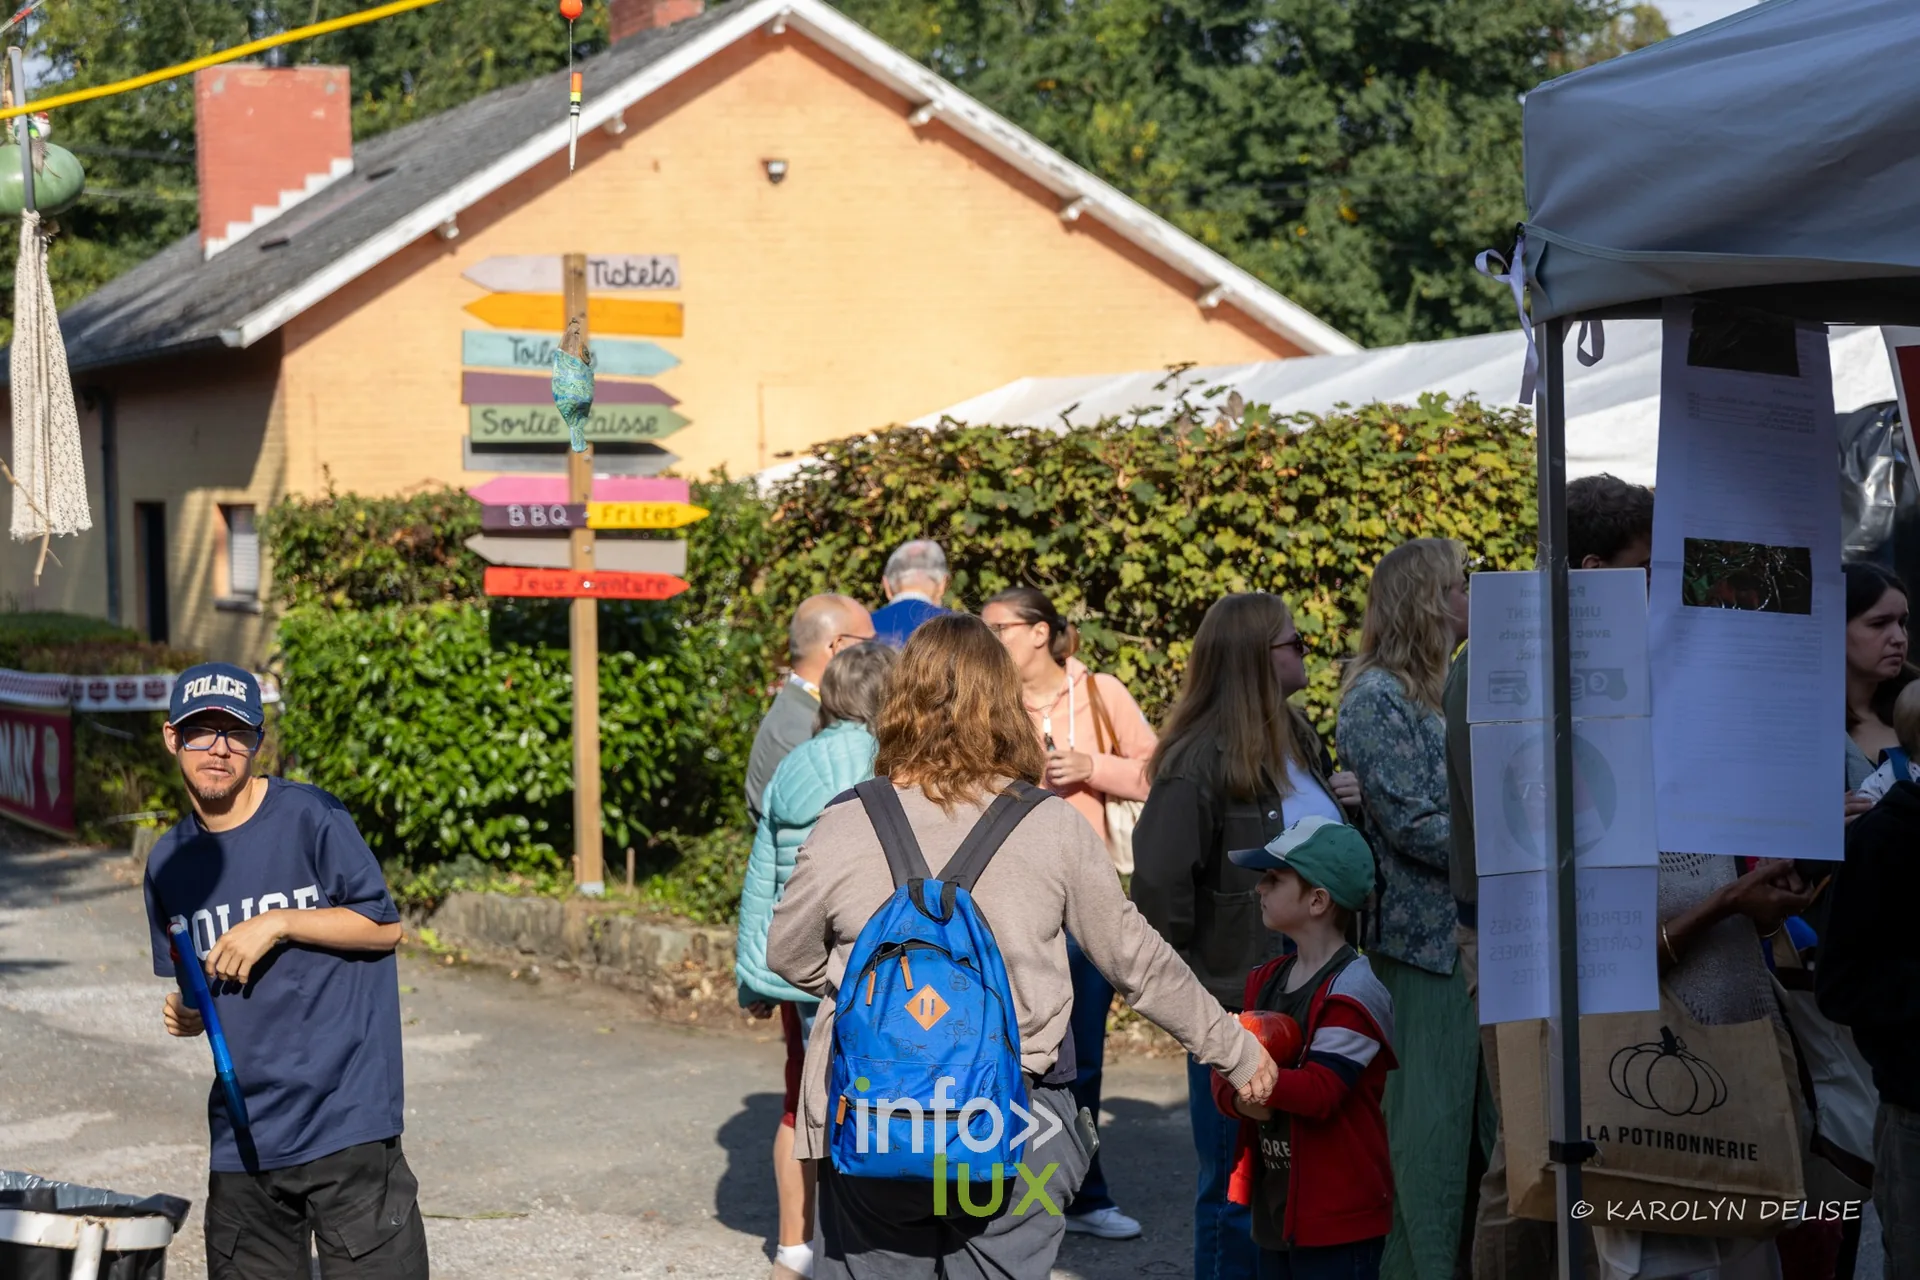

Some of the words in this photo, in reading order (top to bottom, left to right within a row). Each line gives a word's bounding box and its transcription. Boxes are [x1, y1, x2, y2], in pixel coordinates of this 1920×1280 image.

[589, 259, 676, 288] Tickets
[508, 335, 598, 368] Toils
[481, 408, 561, 436] Sortie
[507, 504, 572, 527] BBQ
[182, 674, 248, 704] POLICE
[1586, 1124, 1610, 1142] LA
[1618, 1126, 1758, 1162] POTIRONNERIE
